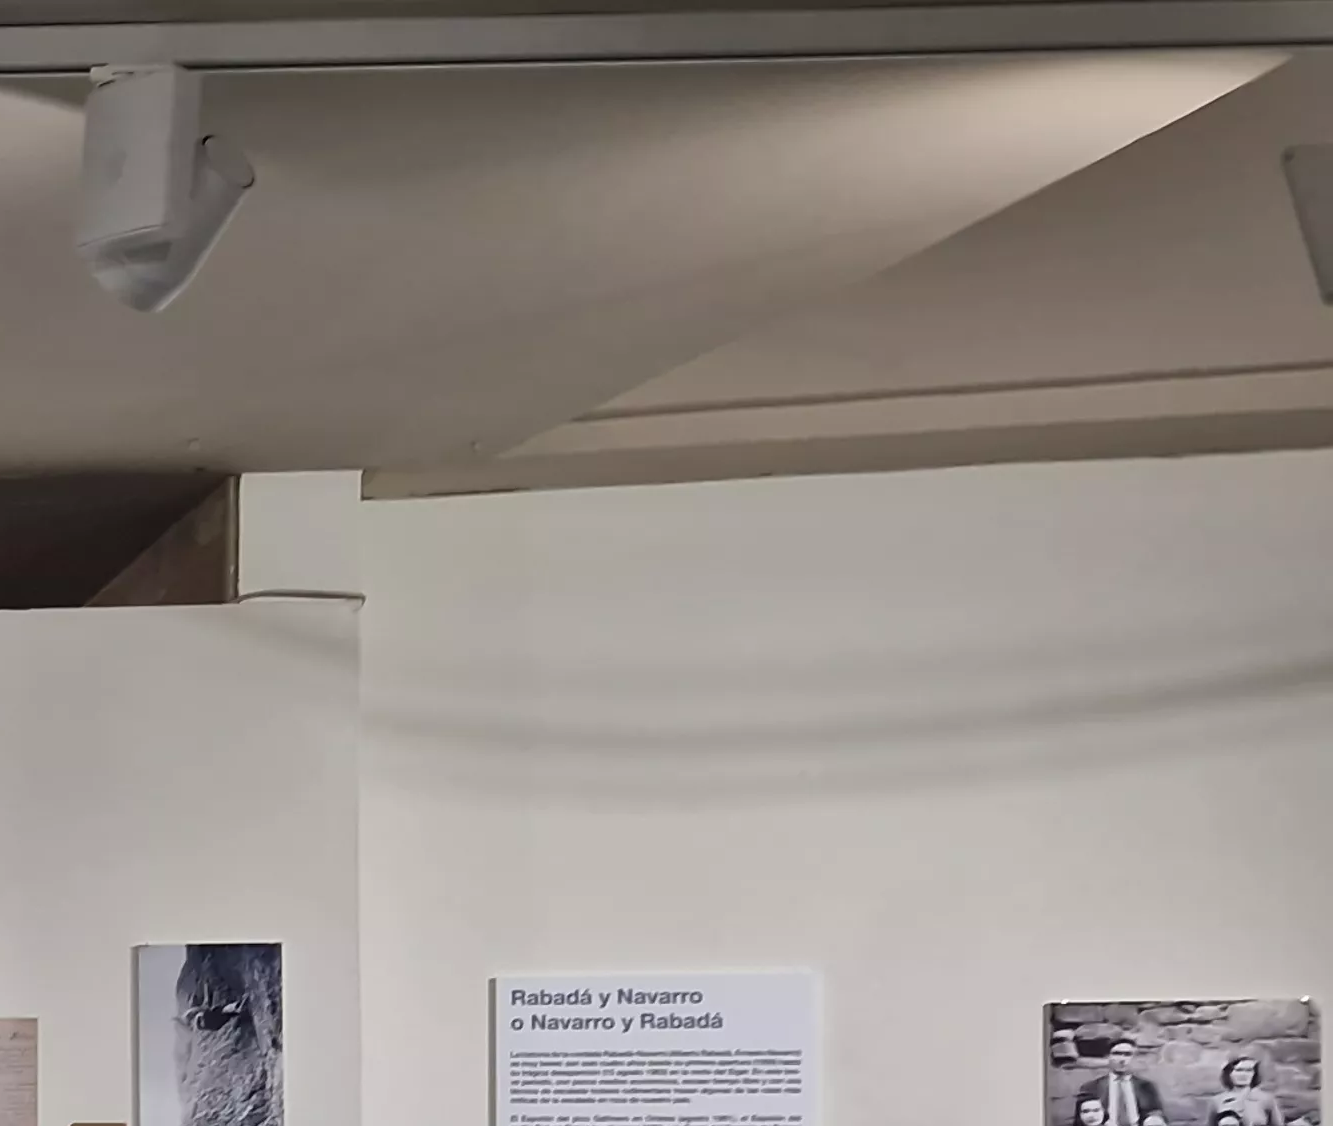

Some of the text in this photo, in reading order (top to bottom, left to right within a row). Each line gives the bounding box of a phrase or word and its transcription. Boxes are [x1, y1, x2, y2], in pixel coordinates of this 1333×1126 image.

[510, 988, 703, 1009] Rabadá y Navarro
[510, 1012, 723, 1033] o Navarro y Rabadá
